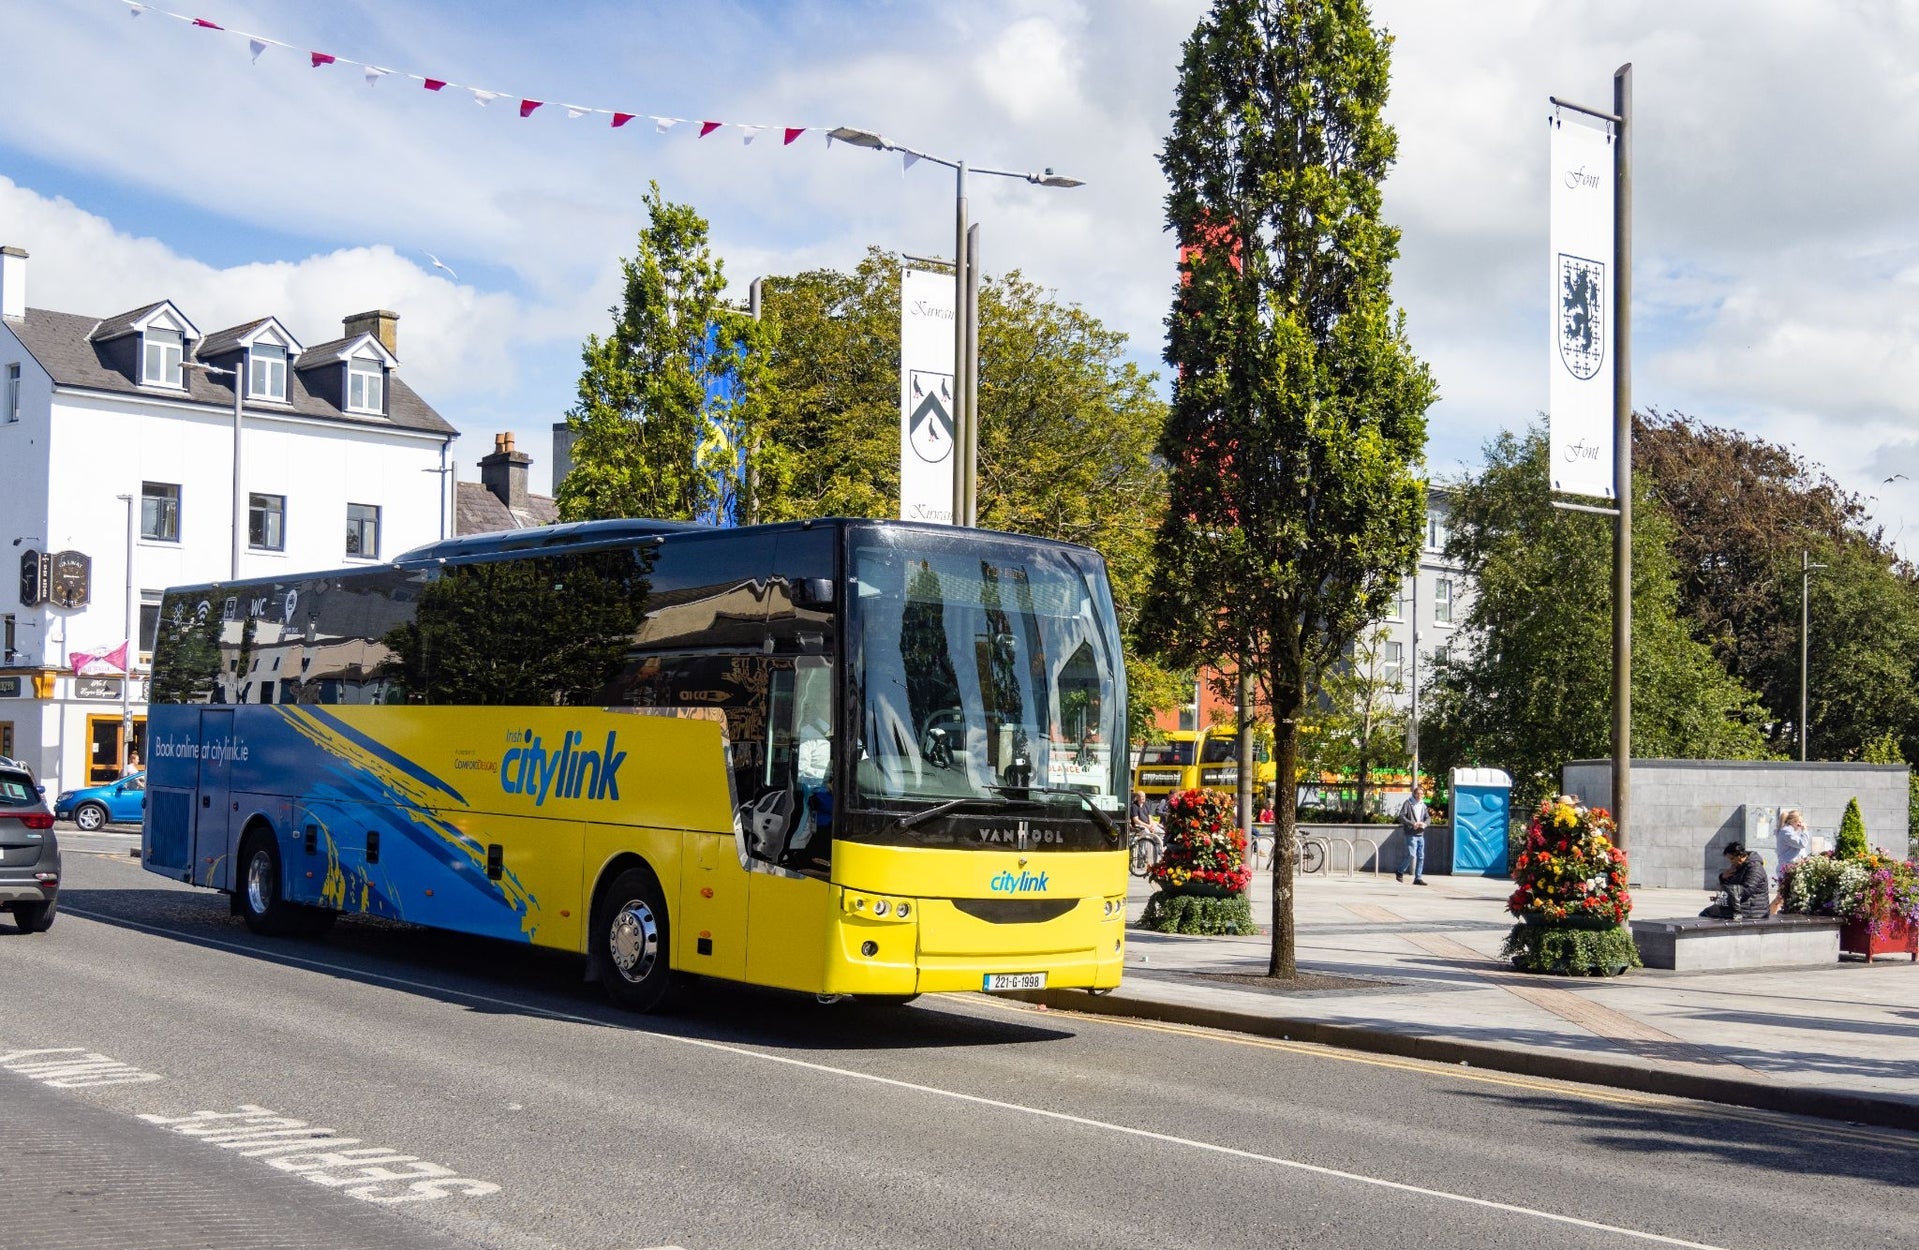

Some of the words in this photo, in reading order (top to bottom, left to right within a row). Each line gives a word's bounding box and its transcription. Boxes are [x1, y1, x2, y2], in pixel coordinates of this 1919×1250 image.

[1564, 165, 1600, 190] Font
[910, 300, 954, 320] Kirwan
[1563, 437, 1600, 463] Font
[251, 597, 267, 616] WC
[506, 728, 523, 742] Irish
[155, 733, 174, 757] Book
[176, 734, 199, 759] online
[201, 740, 210, 759] at
[211, 736, 249, 767] citylink.ie
[501, 728, 627, 806] citylink
[990, 870, 1049, 894] citylink
[995, 976, 1039, 988] 221-G-1998
[135, 1104, 502, 1203] SERVICE
